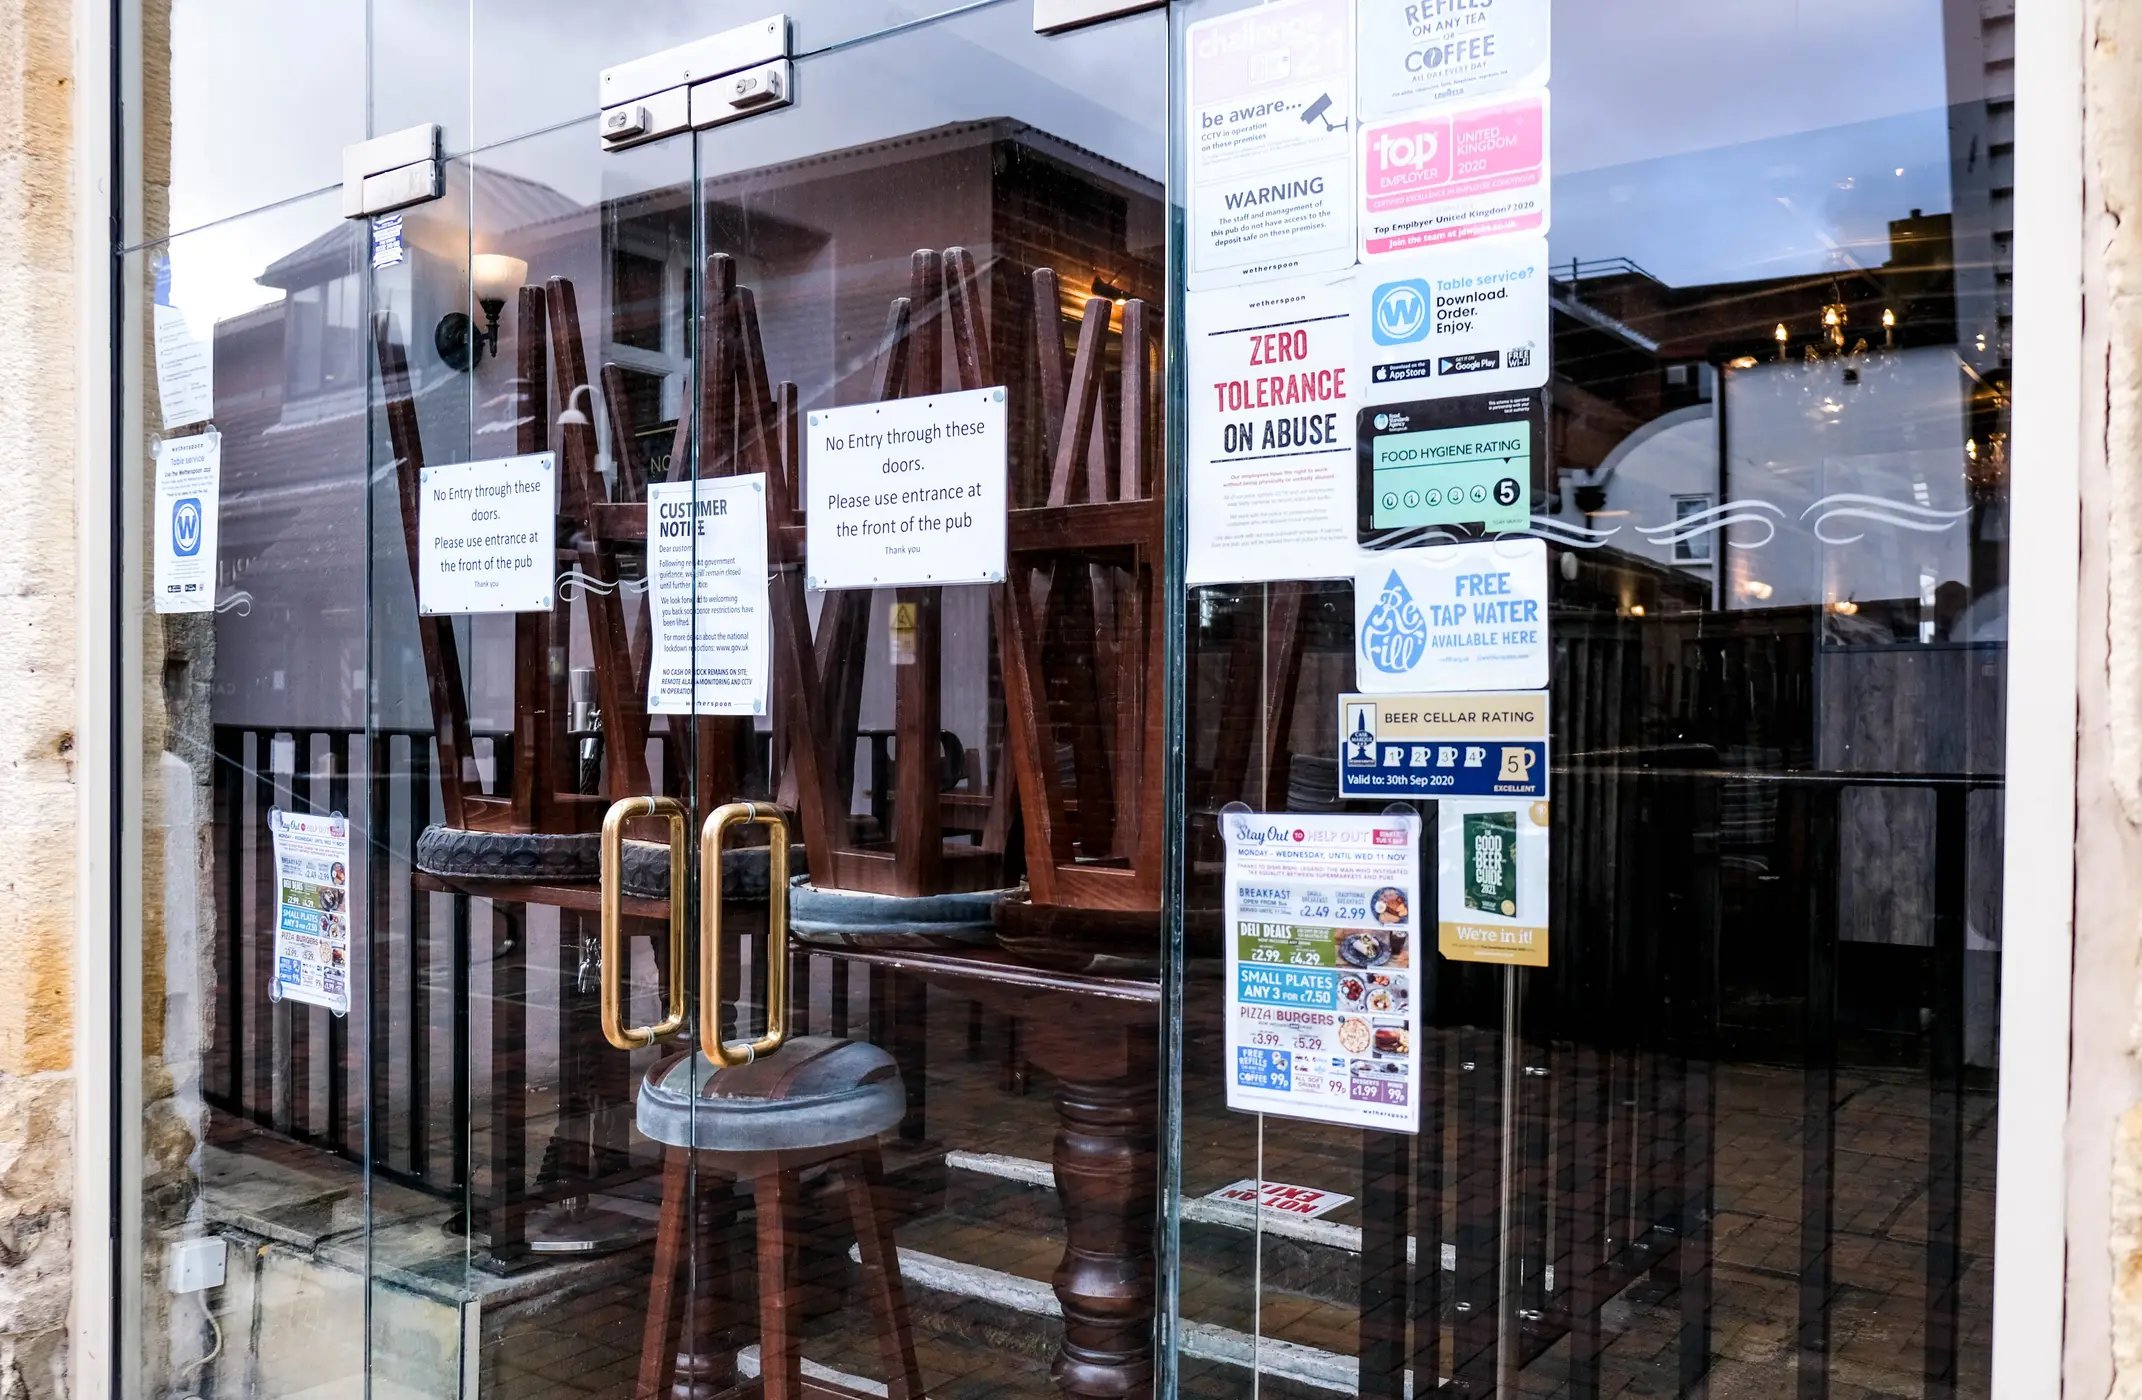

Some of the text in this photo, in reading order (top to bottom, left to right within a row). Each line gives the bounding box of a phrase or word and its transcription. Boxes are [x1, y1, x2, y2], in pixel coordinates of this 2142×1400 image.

[1412, 12, 1486, 37] ON ANY TEA
[1405, 34, 1495, 73] COFFEE
[1201, 102, 1302, 129] be aware...
[1201, 121, 1268, 141] CCTV in operation
[1457, 127, 1500, 144] UNITED
[1212, 140, 1232, 150] these
[1234, 133, 1267, 147] premises
[1373, 132, 1438, 170] top
[1457, 135, 1517, 156] KINGDOM
[1458, 159, 1486, 174] 2020
[1380, 168, 1438, 188] EMPLOYER
[1224, 176, 1324, 210] WARNING
[1219, 200, 1323, 225] The staff and management of
[1225, 227, 1238, 236] pub
[1240, 223, 1250, 231] do
[1251, 221, 1263, 230] not
[1265, 218, 1282, 227] have
[1284, 215, 1307, 224] access
[1319, 210, 1331, 218] the
[1215, 236, 1242, 247] deposit
[1243, 233, 1257, 242] safe
[1270, 228, 1290, 237] these
[1292, 222, 1327, 235] premises.
[1241, 260, 1299, 275] wetherspoon
[1436, 266, 1535, 292] Table service?
[1248, 295, 1306, 309] wetherspoon
[1436, 287, 1508, 308] Download.
[1436, 306, 1478, 320] Order.
[1436, 320, 1474, 335] Enjoy.
[1249, 329, 1308, 367] ZERO
[1389, 366, 1426, 380] App Store
[1455, 358, 1496, 372] Google Play
[1214, 368, 1347, 412] TOLERANCE
[825, 421, 985, 452] No Entry through these
[1224, 413, 1337, 453] ON ABUSE
[1381, 439, 1521, 463] FOOD HYGIENE RATING
[882, 458, 925, 475] doors.
[433, 479, 541, 503] No Entry through these
[828, 483, 983, 511] Please use entrance at
[1386, 496, 1394, 506] 0
[1430, 492, 1437, 503] 2
[1452, 491, 1459, 501] 3
[1474, 489, 1482, 499] 4
[1499, 481, 1513, 503] 5
[471, 508, 502, 523] doors.
[660, 499, 728, 519] CUSTMER
[660, 519, 706, 538] NOTIE
[836, 512, 973, 538] the front of the pub
[434, 531, 539, 550] Please use entrance at
[884, 546, 921, 556] Thank you
[440, 555, 533, 573] the front of the pub
[474, 580, 500, 589] Thank you
[1455, 572, 1511, 597] FREE
[741, 605, 754, 613] have
[1429, 599, 1538, 627] TAP WATER
[727, 632, 749, 640] national
[1431, 630, 1538, 648] AVAILABLE HERE
[716, 644, 749, 653] www.gov.uk
[1384, 711, 1535, 724] BEER CELLAR RATING
[1389, 751, 1519, 773] 1 2 3 4 5
[1347, 774, 1455, 787] Valid to: 30th Sep 2020
[1237, 824, 1289, 846] Stay Out
[1475, 835, 1502, 852] GOOD
[1475, 851, 1502, 871] BEER
[1475, 869, 1502, 887] GUIDE
[1239, 888, 1291, 900] BREAKFAST
[1481, 885, 1497, 895] 2021
[283, 909, 319, 923] SMALL PLATES
[1300, 905, 1366, 920] £2.49 £2.99
[1240, 923, 1259, 936] DELI
[1263, 925, 1292, 939] DEALS
[1457, 926, 1533, 944] We're in it!
[1241, 970, 1333, 989] SMALL PLATES
[1244, 985, 1331, 1003] ANY 3 £7.50
[1241, 1006, 1271, 1020] PIZZA
[1276, 1010, 1334, 1025] BURGERS
[1261, 1199, 1319, 1213] NOT
